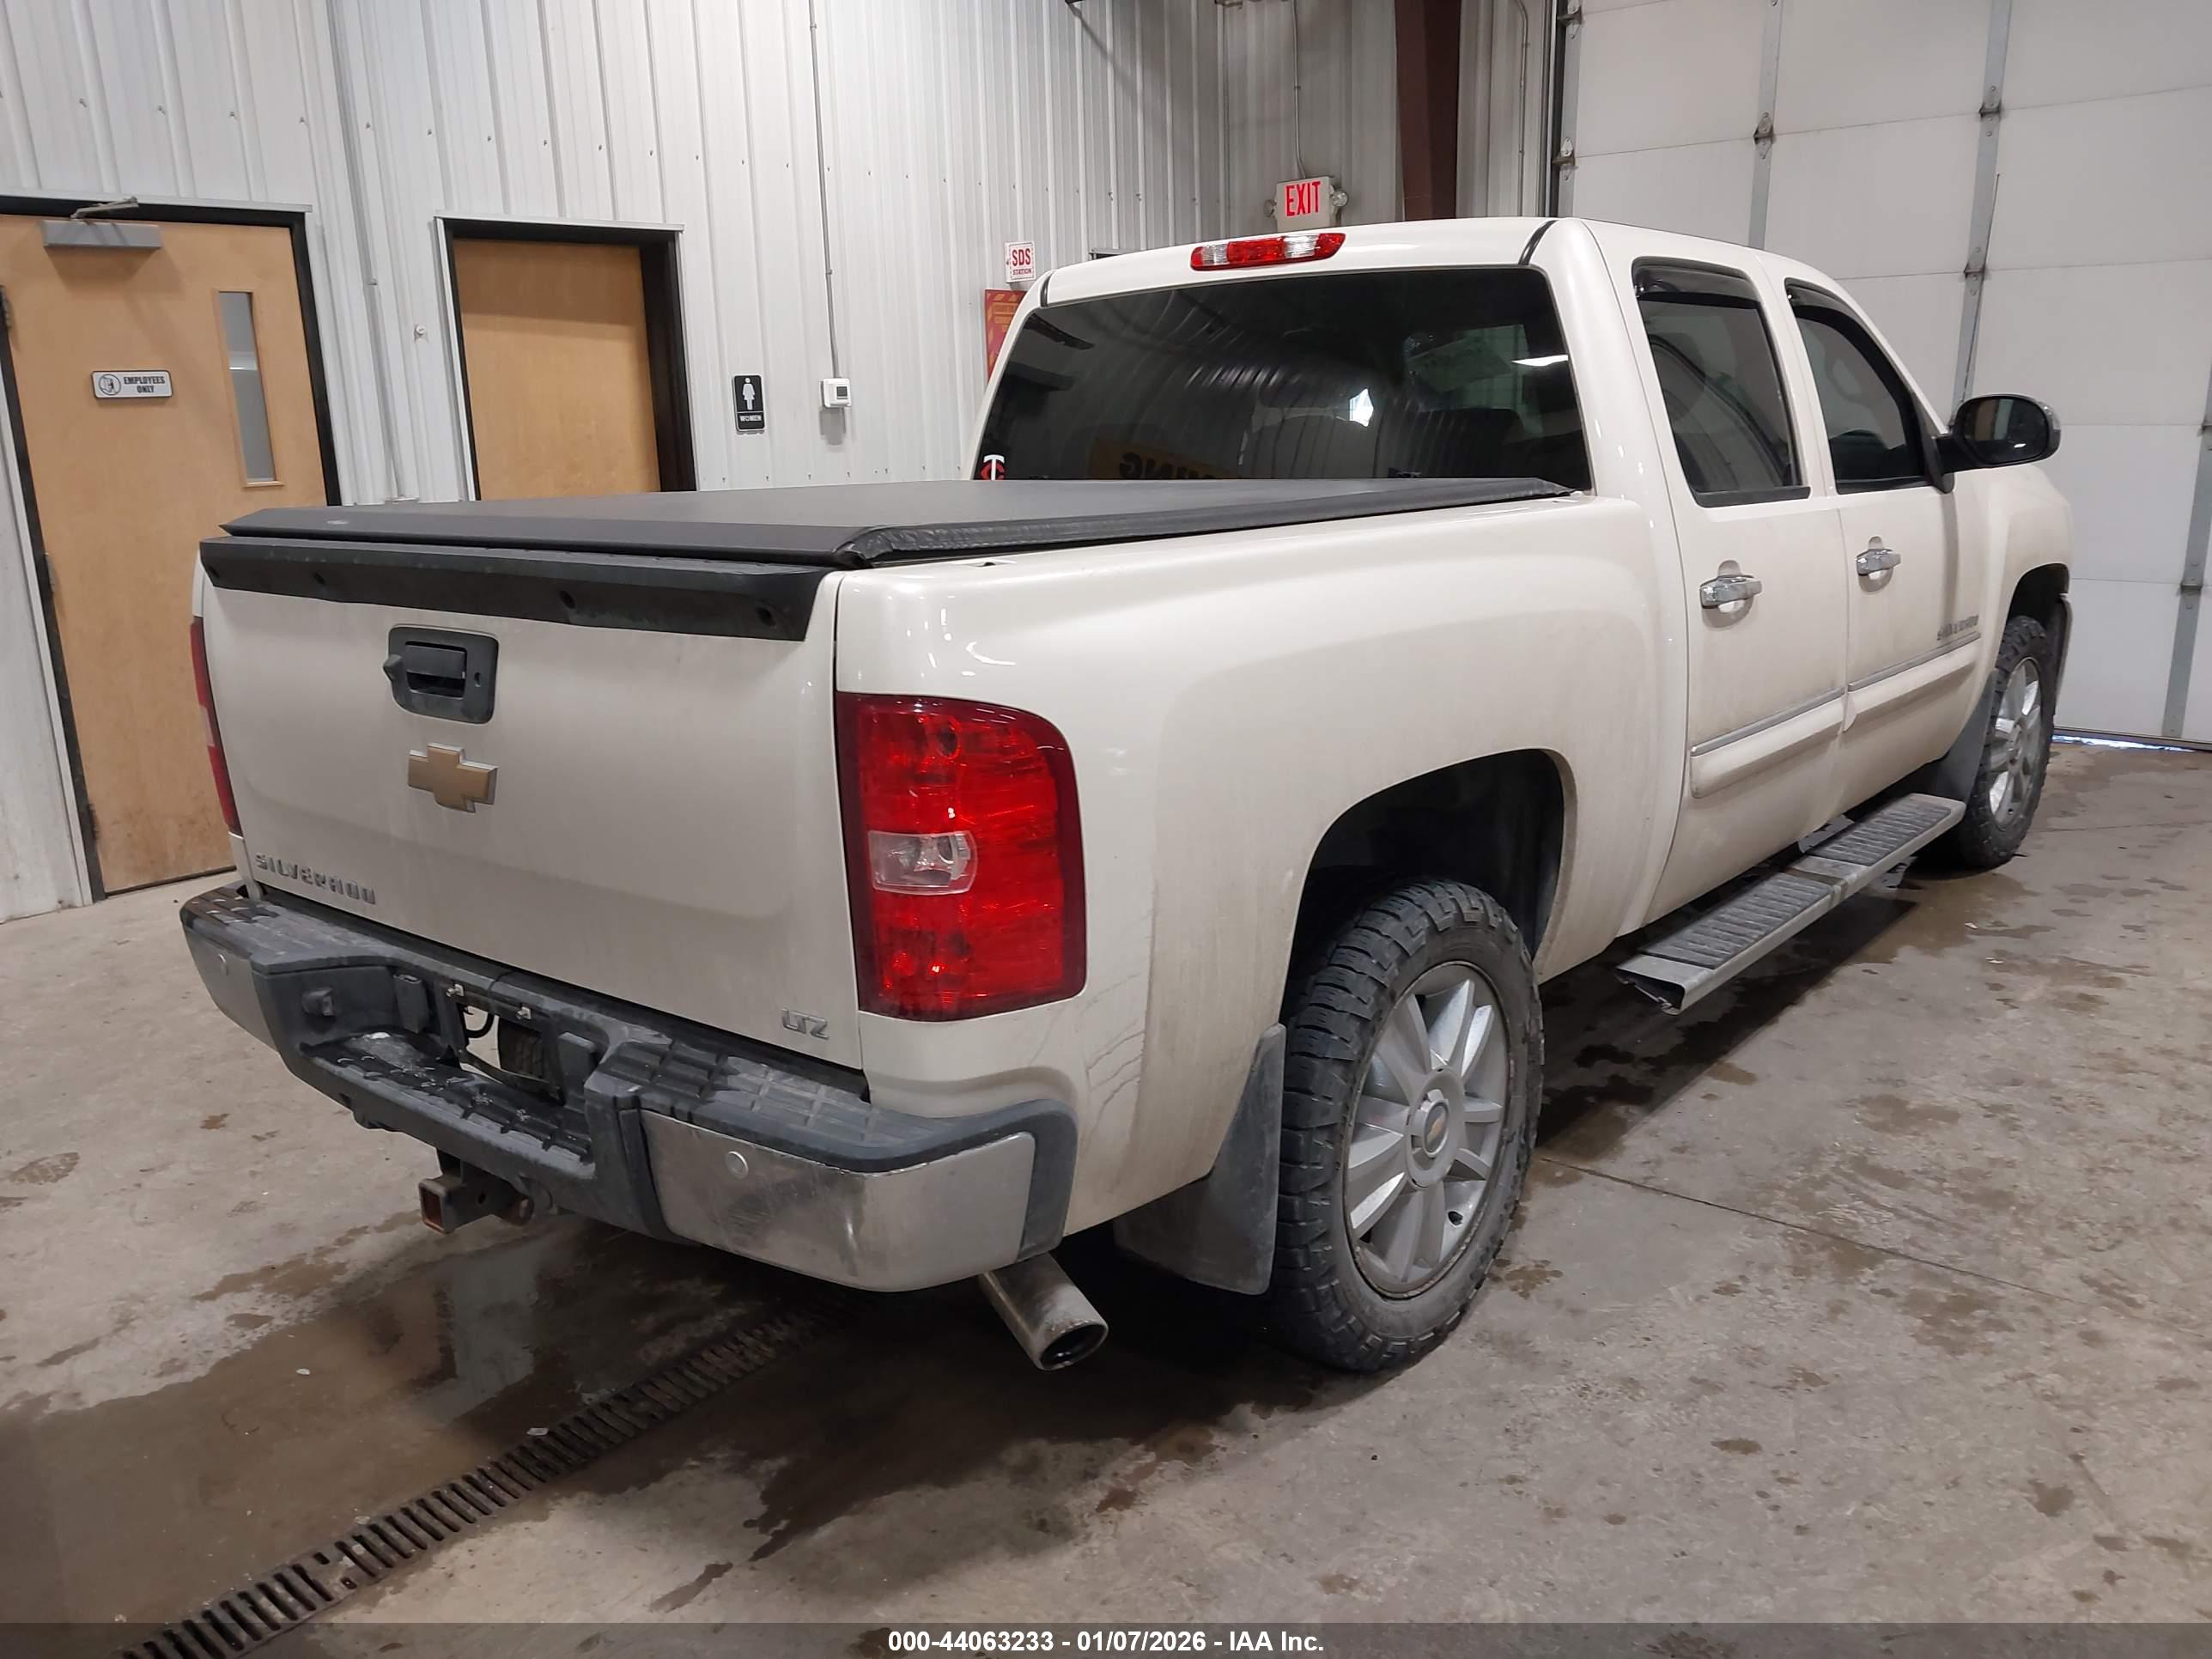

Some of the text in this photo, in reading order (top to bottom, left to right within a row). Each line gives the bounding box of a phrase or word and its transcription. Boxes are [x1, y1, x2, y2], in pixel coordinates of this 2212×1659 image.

[1286, 181, 1321, 216] EXIT
[1012, 248, 1031, 266] SDS
[123, 376, 166, 385] EMPLOYEES
[256, 853, 376, 905] SILVERADO
[781, 1008, 830, 1041] LTZ
